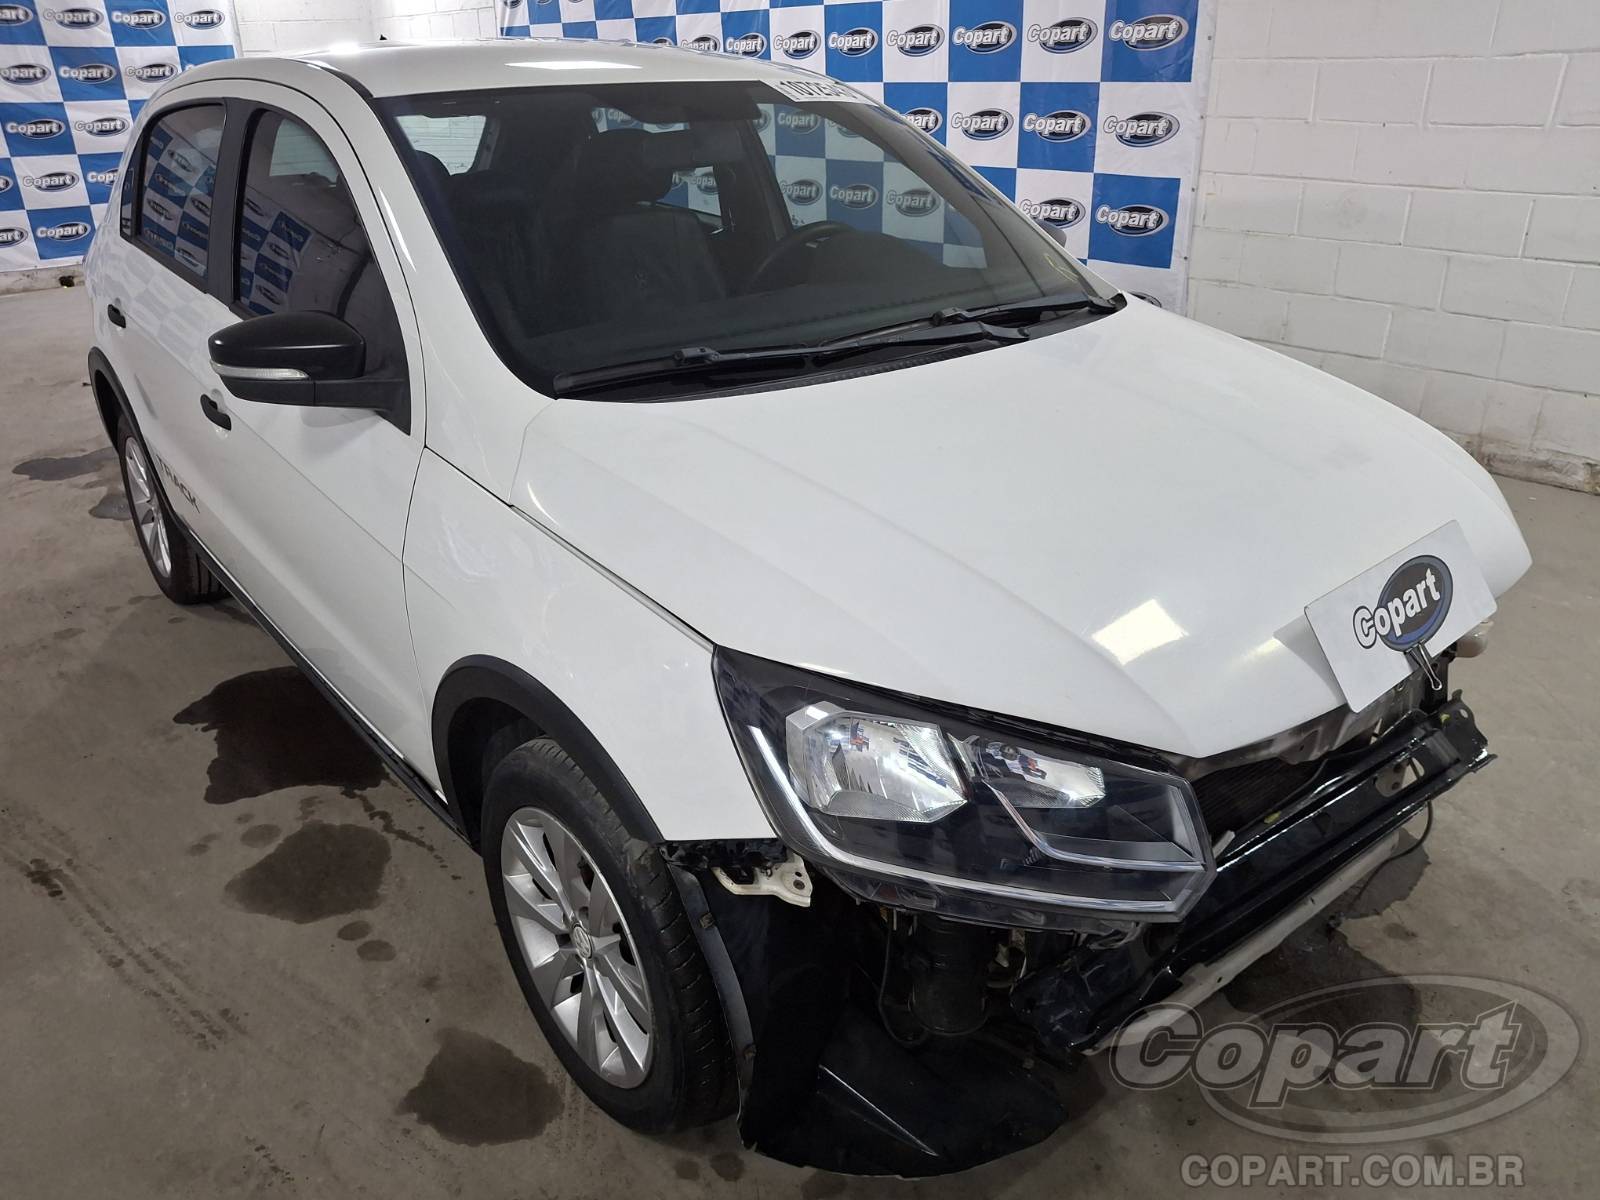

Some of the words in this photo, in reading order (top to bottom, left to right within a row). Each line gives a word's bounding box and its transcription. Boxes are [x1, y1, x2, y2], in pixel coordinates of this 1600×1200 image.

[0, 9, 25, 20] art
[43, 9, 95, 24] Copart
[111, 11, 159, 26] Copart
[174, 12, 218, 25] Copart
[887, 28, 937, 50] Copart
[952, 25, 1008, 48] Copart
[1027, 22, 1091, 46] Copart
[1109, 18, 1180, 42] Copart
[725, 37, 762, 54] Copart
[773, 34, 816, 52] Copart
[829, 31, 873, 52] Copart
[0, 67, 42, 81] opart
[59, 65, 109, 81] Copart
[126, 65, 171, 78] Copart
[6, 121, 59, 136] Copart
[75, 119, 122, 133] Copart
[777, 112, 816, 129] Copart
[951, 111, 1004, 135] Copart
[1023, 113, 1082, 137] Copart
[1103, 116, 1170, 138] Copart
[23, 174, 72, 189] Copart
[780, 180, 818, 199] Copart
[830, 185, 874, 203] Copart
[888, 189, 933, 210] Copart
[1020, 199, 1077, 221] Copart
[1096, 204, 1160, 229] Copart
[0, 229, 20, 241] art
[37, 222, 85, 238] Copart
[1353, 568, 1441, 649] Copart
